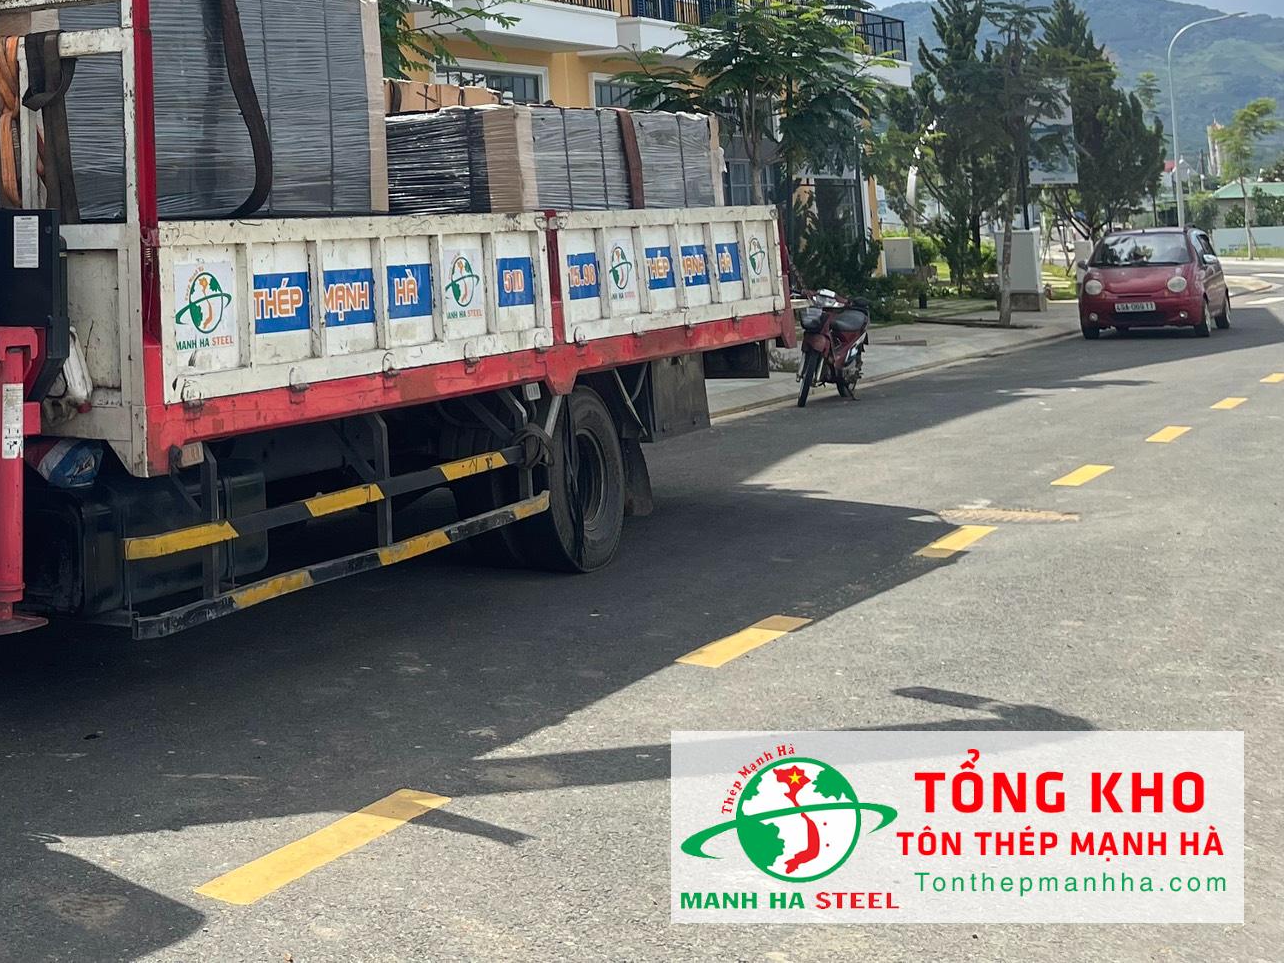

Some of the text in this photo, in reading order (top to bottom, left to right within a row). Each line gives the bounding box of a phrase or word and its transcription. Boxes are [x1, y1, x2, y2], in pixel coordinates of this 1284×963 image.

[394, 269, 418, 306] HÀ
[503, 269, 525, 293] 51D
[569, 263, 596, 287] 15.98
[253, 278, 303, 319] THÉP
[324, 281, 369, 321] MẠNH
[200, 337, 209, 347] HA
[212, 335, 234, 346] STEEL
